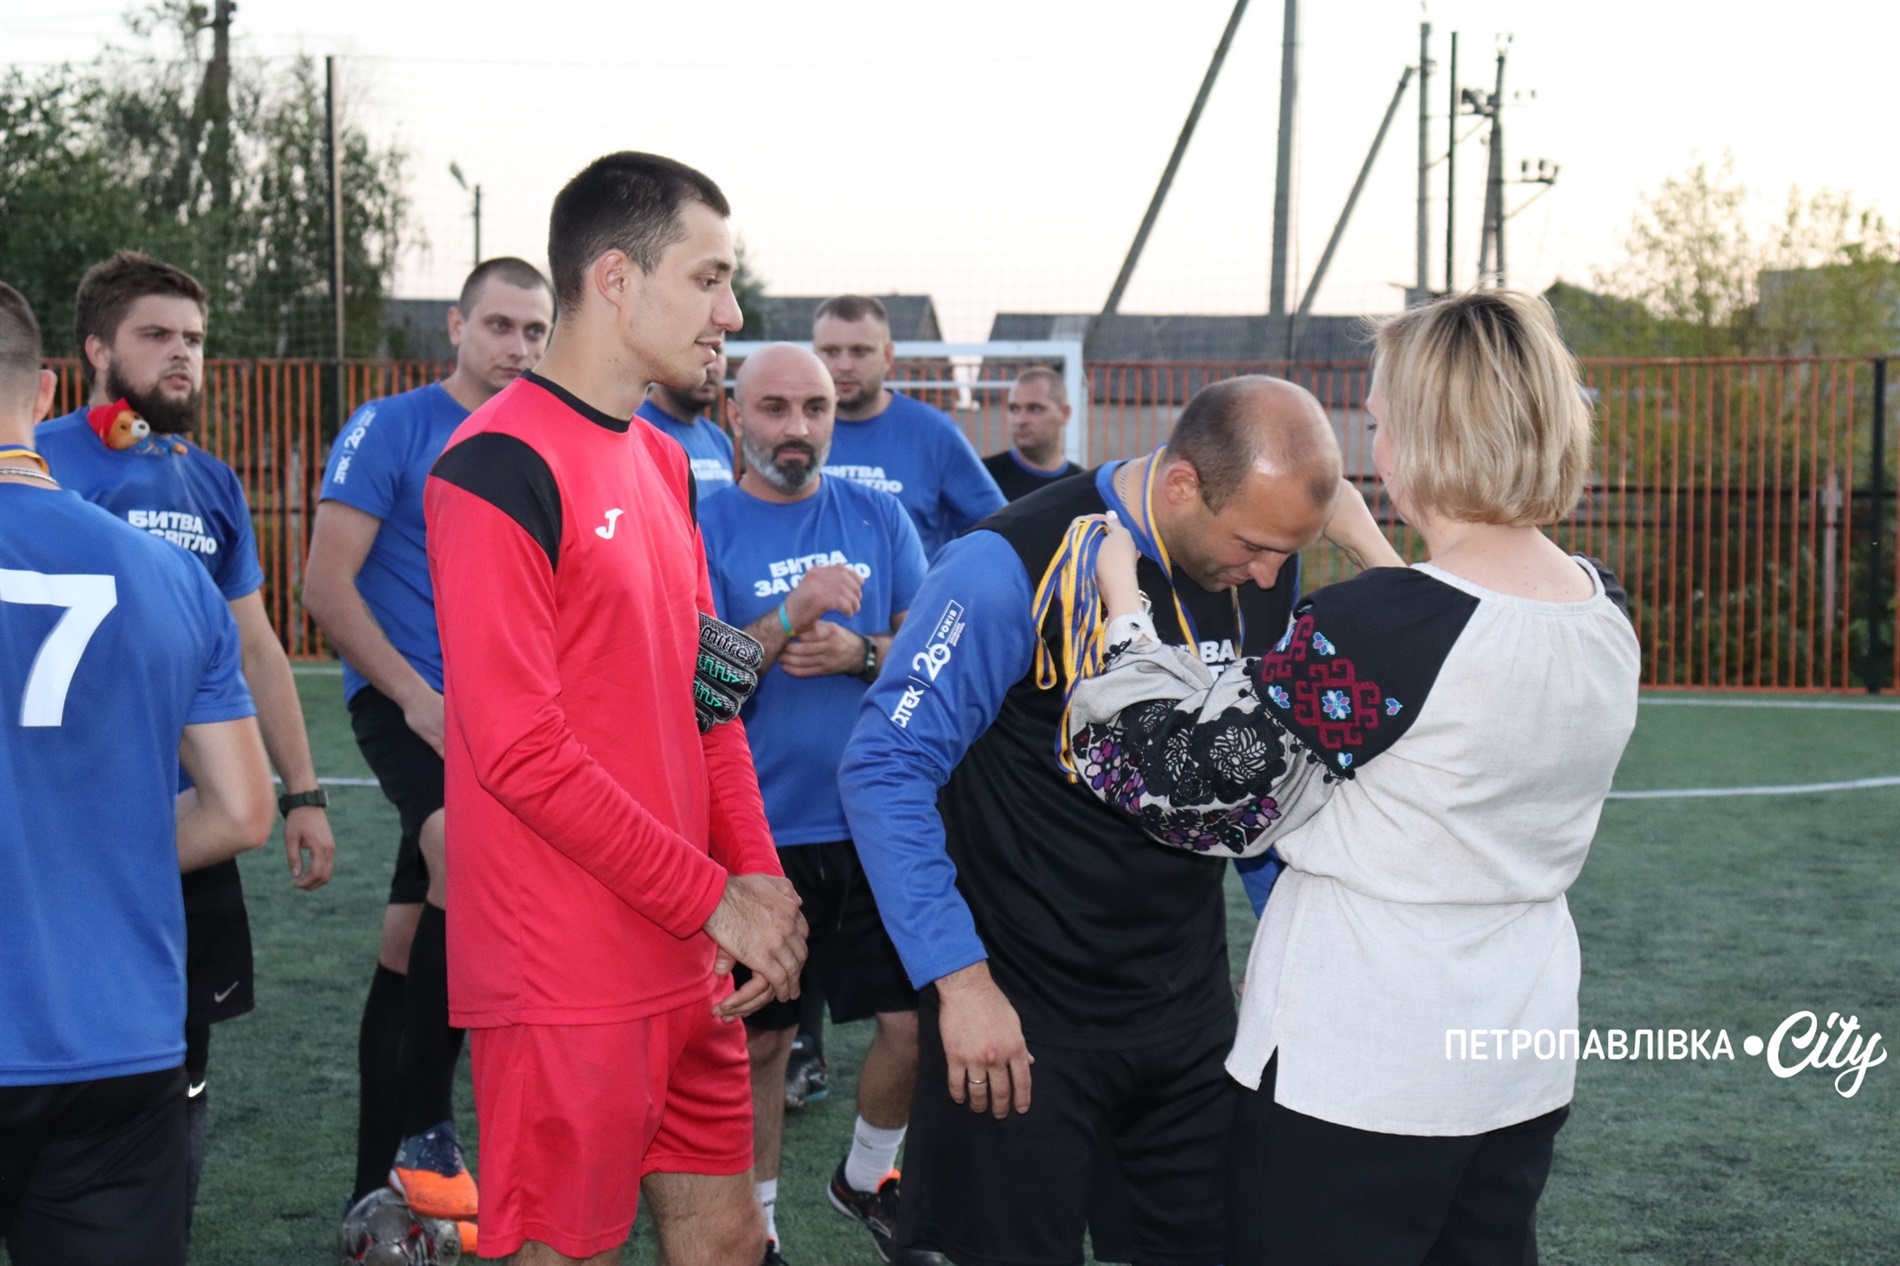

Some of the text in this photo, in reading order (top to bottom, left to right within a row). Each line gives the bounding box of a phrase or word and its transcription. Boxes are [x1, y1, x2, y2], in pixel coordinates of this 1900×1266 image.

[128, 510, 204, 534] БИТВА
[769, 550, 848, 578] БИТВА
[754, 578, 791, 597] ЗА
[0, 568, 117, 727] 7
[701, 626, 749, 661] mitre
[912, 643, 951, 681] 20
